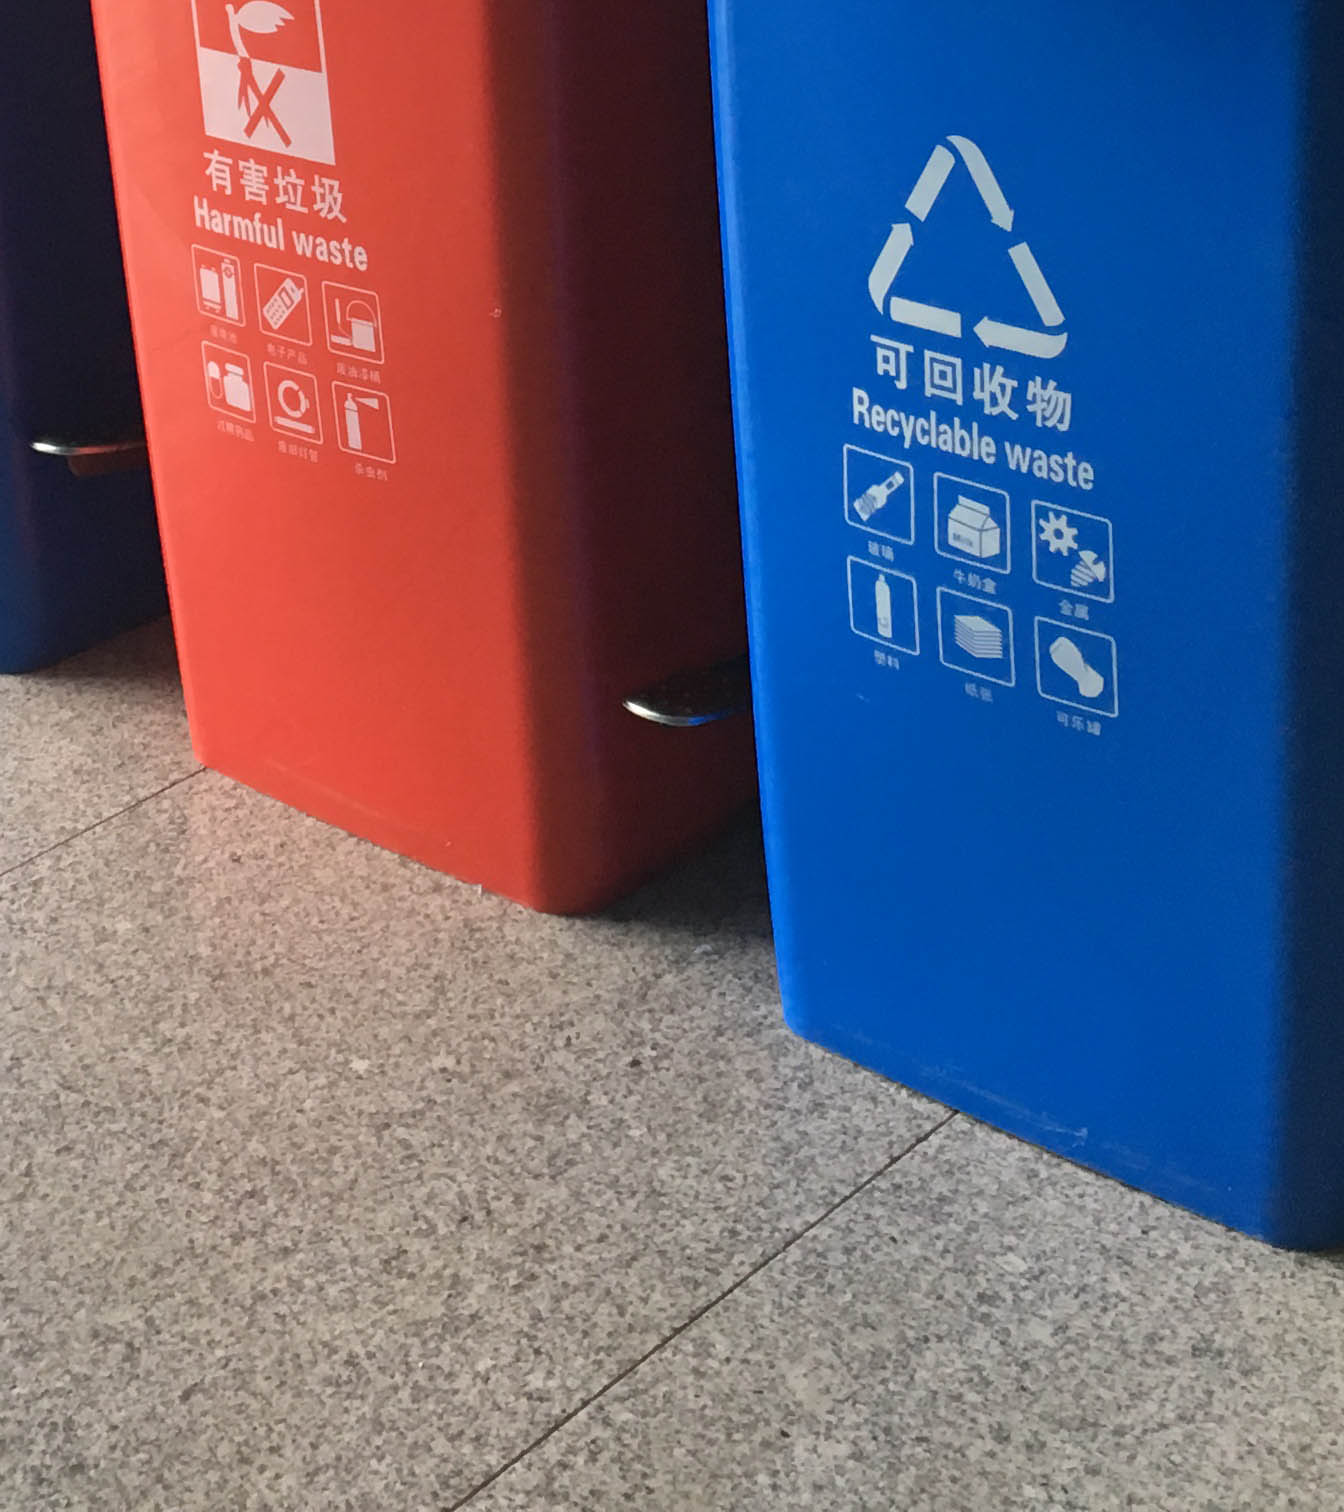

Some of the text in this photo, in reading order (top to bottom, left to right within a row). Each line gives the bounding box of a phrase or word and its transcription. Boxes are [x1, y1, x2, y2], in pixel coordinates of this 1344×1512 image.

[203, 149, 347, 224] 有害垃圾
[193, 194, 368, 272] Harmful waste
[870, 334, 1072, 432] 可回收物
[852, 386, 1095, 490] Recyclable waste
